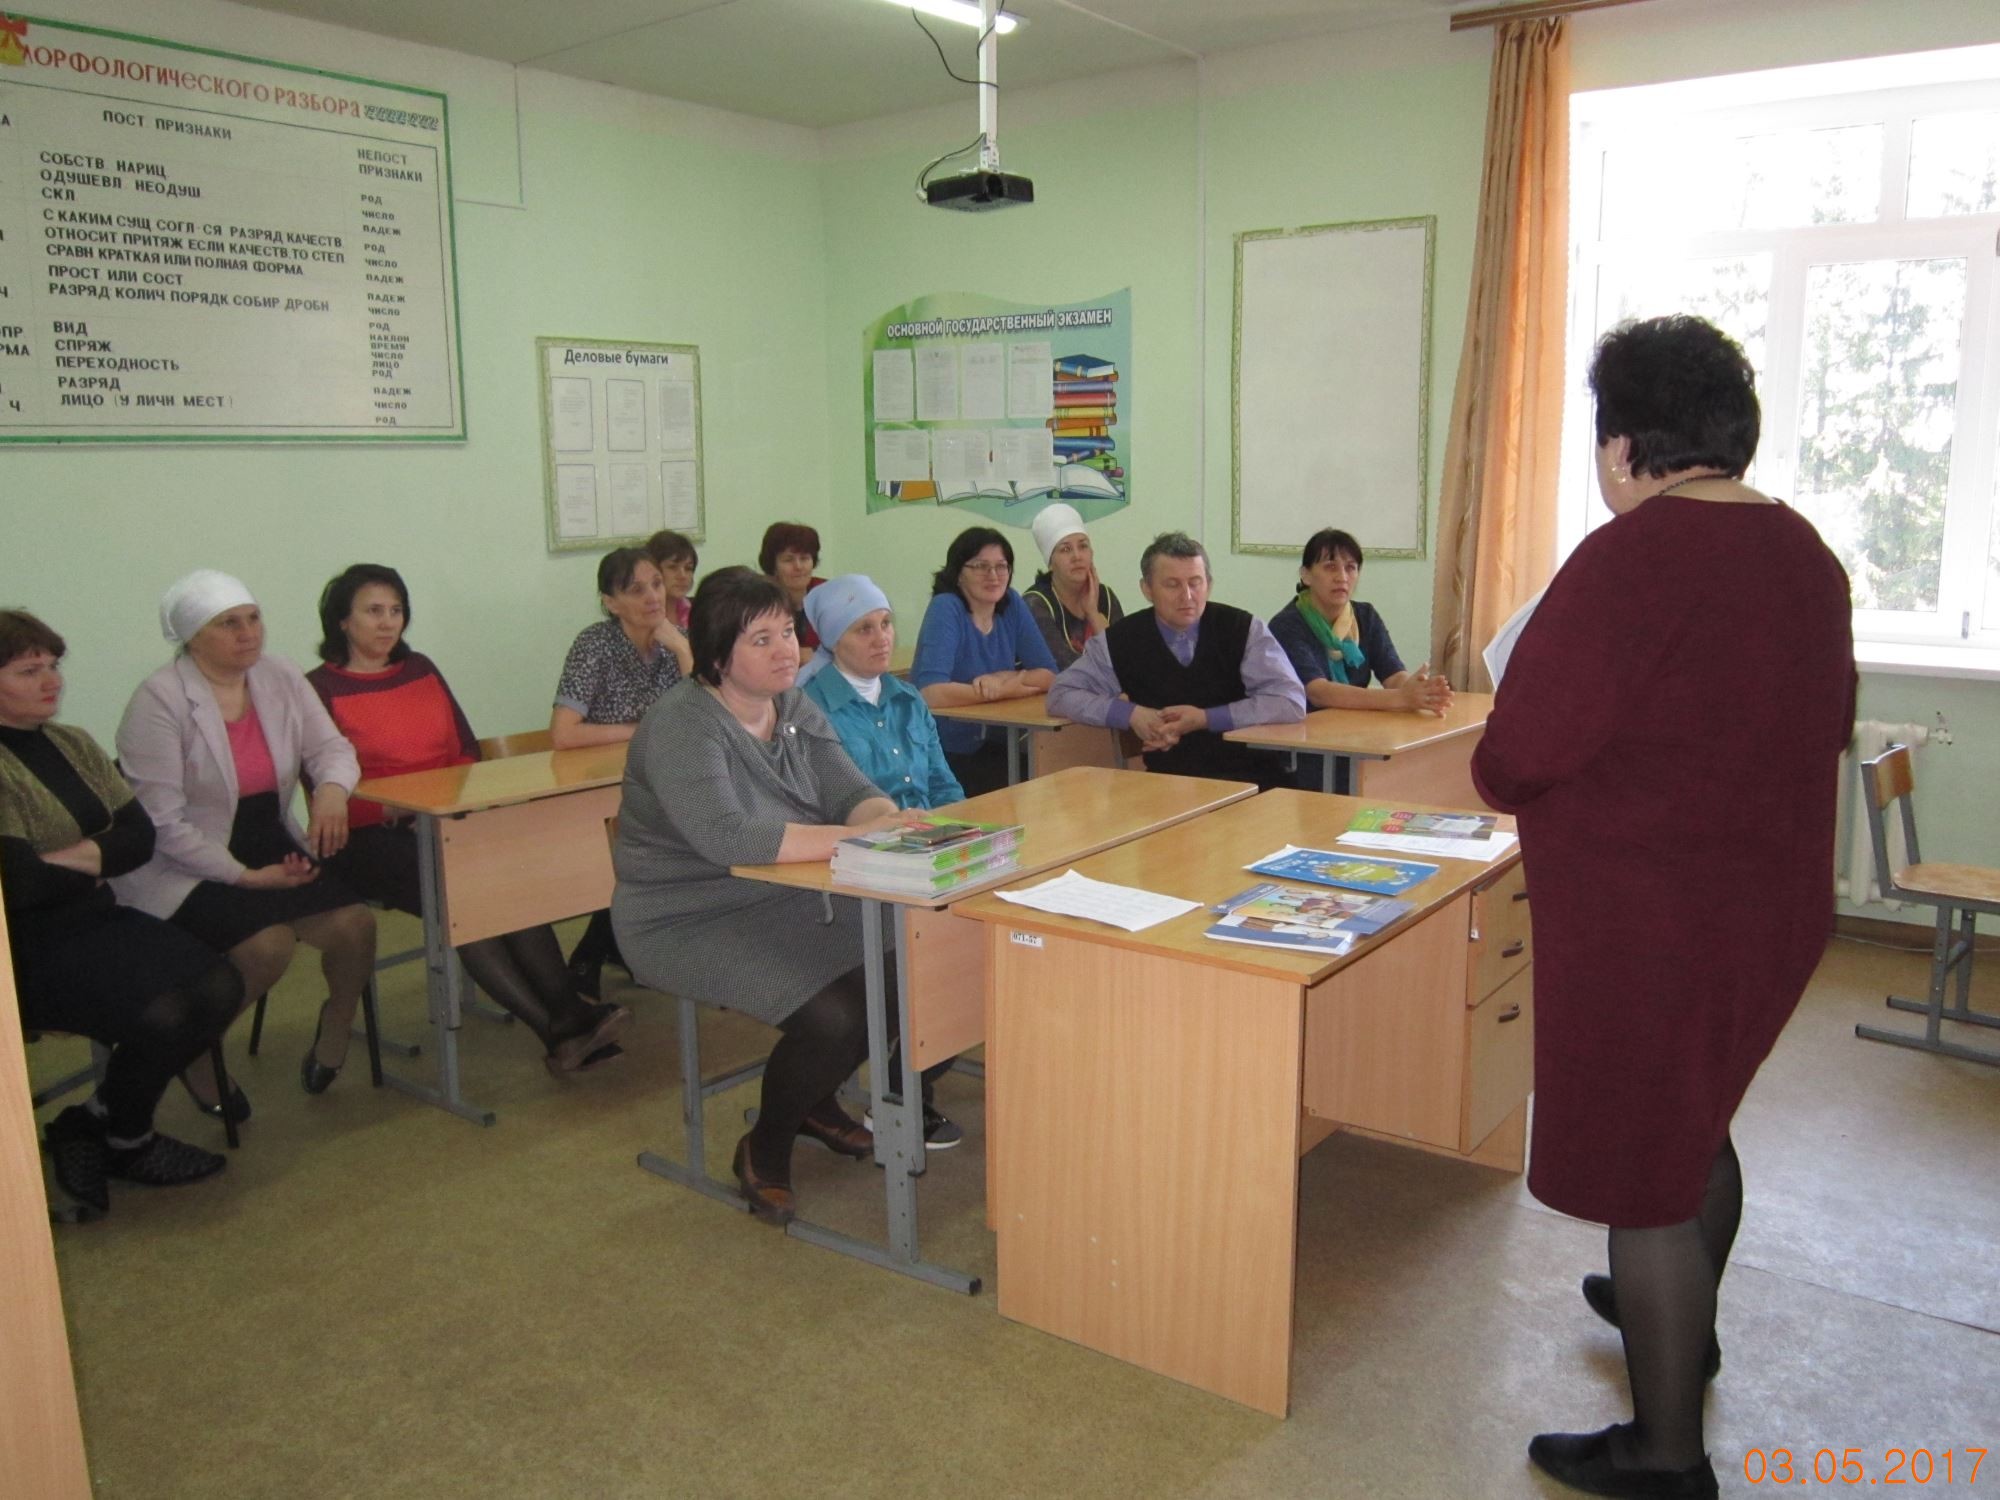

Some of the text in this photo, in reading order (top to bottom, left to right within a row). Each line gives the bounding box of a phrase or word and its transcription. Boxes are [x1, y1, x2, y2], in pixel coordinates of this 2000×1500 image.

[103, 110, 145, 128] ПОСТ
[155, 119, 232, 141] ПРИЗНАКИ
[357, 148, 407, 166] НЕПОСТ
[40, 151, 167, 178] СОБСТВ НАРИЦ
[359, 163, 423, 183] ПРИЗНАКИ
[40, 169, 201, 199] ОДУШЕВЛ НЕОДУШ
[41, 187, 75, 201] СКЛ
[361, 194, 383, 206] РОД
[362, 209, 395, 221] ЧИСЛО
[43, 208, 54, 221] С
[58, 210, 113, 226] КАКИМ
[116, 215, 152, 232] СУЩ
[230, 226, 283, 243] РАЗРЯД
[362, 224, 401, 237] ПАДЕЖ
[44, 226, 117, 243] ОТНОСИТ
[123, 233, 183, 249] ПРИТЯЖ
[188, 239, 225, 252] ЕСЛИ
[312, 250, 345, 264] СТЕП
[364, 243, 385, 255] РОД
[46, 244, 304, 276] СРАВН КРАТКАЯ ИЛИ ПОЛНАЯ ФОРМА
[365, 258, 398, 269] ЧИСЛО
[48, 264, 183, 286] ПРОСТ ИЛИ СОСТ
[366, 273, 404, 284] ПАДЕЖ
[49, 282, 329, 313] РАЗРЯД КОЛИЧ ПОРЯДК СОБИР ДРОБН
[367, 292, 405, 303] ПАДЕЖ
[368, 307, 400, 317] ЧИСЛО
[53, 321, 88, 337] ВИД
[369, 322, 390, 332] РОД
[887, 308, 1113, 338] ОСНОВНОЙ ГОСУДАРСТВЕННЫЙ ЭКЗАМЕН
[370, 334, 410, 343] НАКЛОН
[55, 339, 112, 353] СПРЯЖ
[371, 352, 404, 360] ЧИСЛО
[564, 349, 669, 367] Деловые бумаги
[56, 356, 180, 372] ПЕРЕХОДНОСТЬ
[58, 376, 121, 391] РАЗРЯД
[373, 387, 411, 397] ПАДЕЖ
[61, 394, 104, 408] ЛИЦО
[136, 394, 175, 407] ЛИЧН
[374, 401, 407, 410] ЧИСЛО
